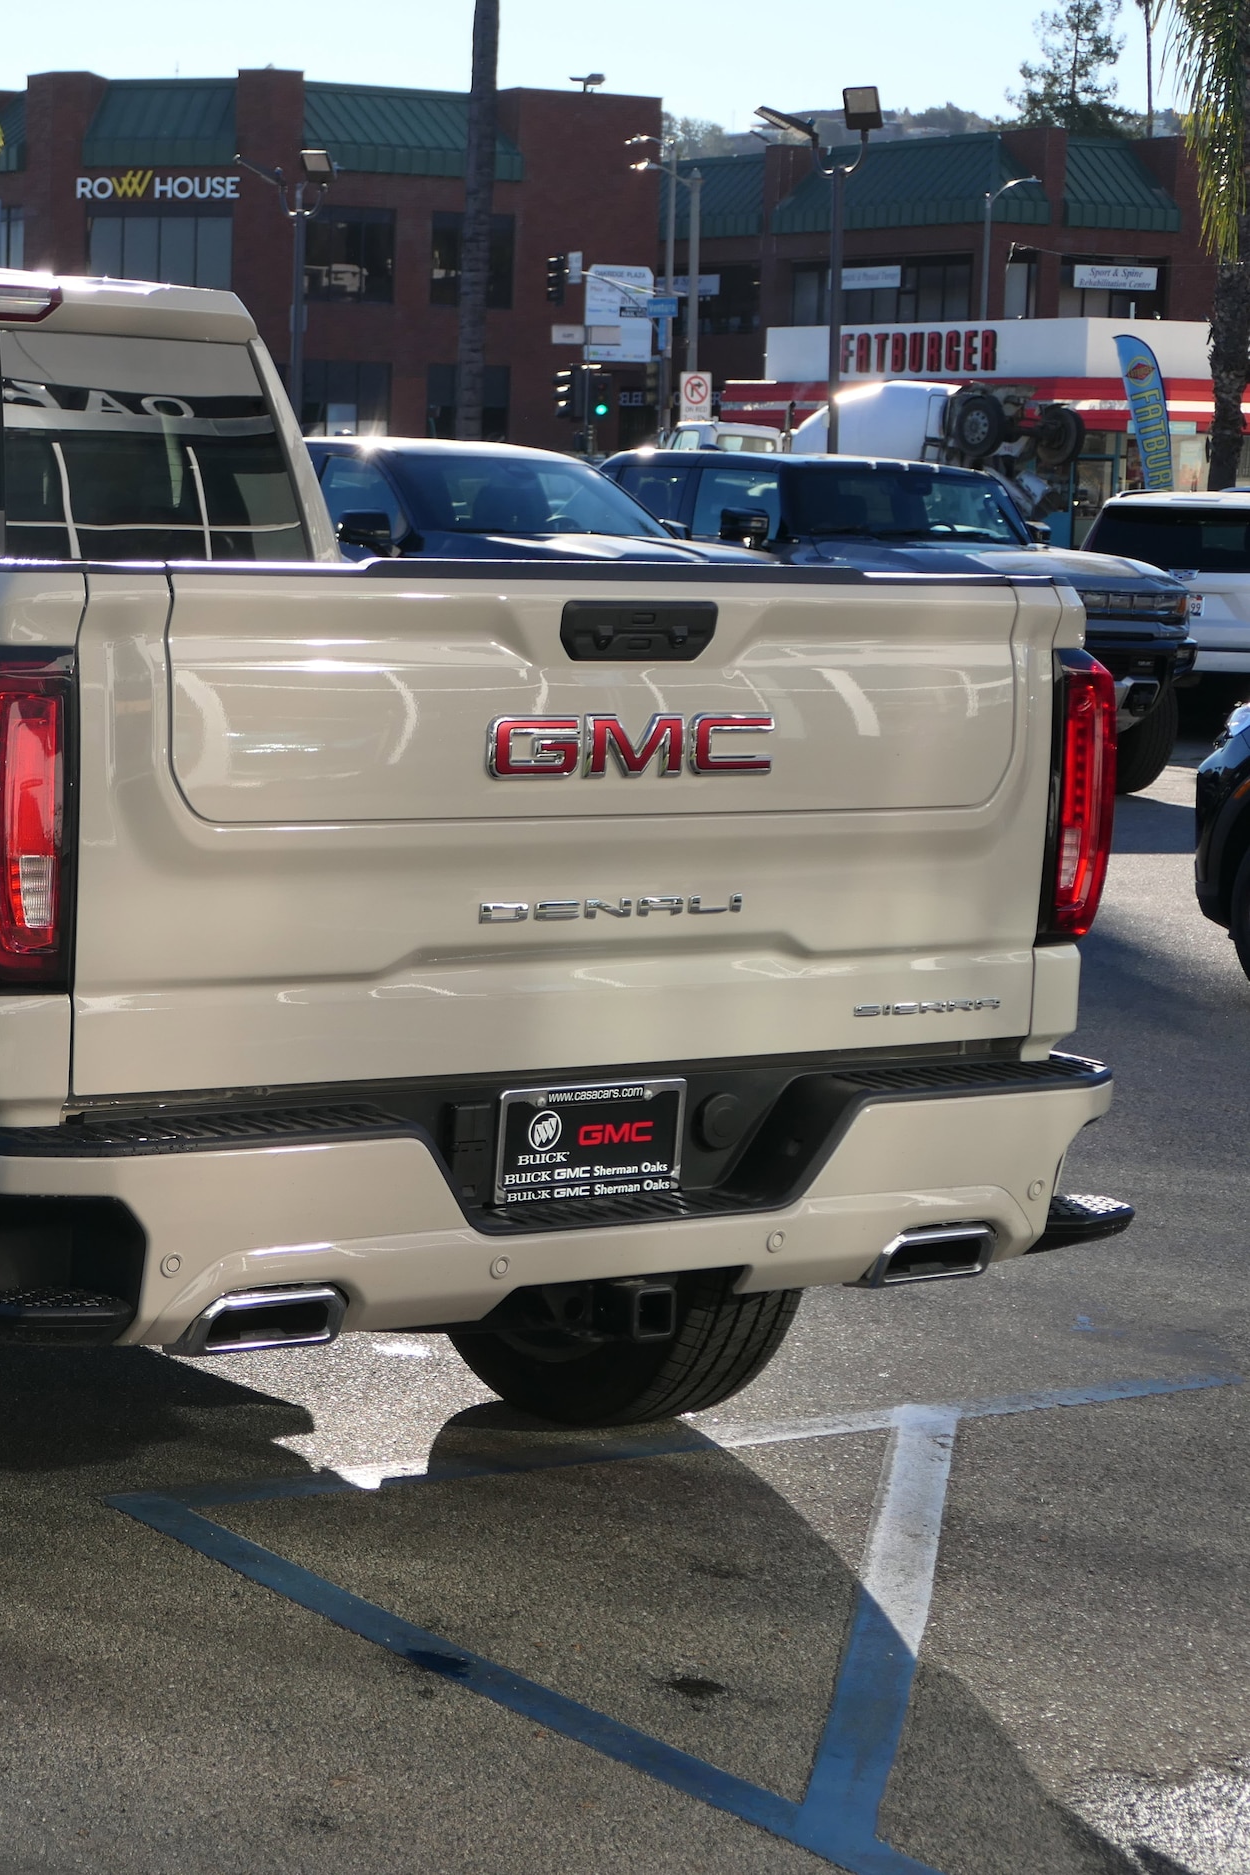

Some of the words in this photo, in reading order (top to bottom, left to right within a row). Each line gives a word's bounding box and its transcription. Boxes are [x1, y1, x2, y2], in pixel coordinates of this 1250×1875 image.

[76, 170, 154, 198] ROW
[154, 176, 241, 199] HOUSE
[627, 271, 646, 279] PLAZA
[1079, 278, 1127, 288] Rehabilitation
[1128, 281, 1152, 289] Center
[1089, 267, 1110, 278] Sport
[1112, 269, 1119, 277] &
[1121, 268, 1143, 279] Spine
[841, 330, 998, 374] FATBURGER
[486, 711, 776, 781] GMC
[478, 892, 743, 924] DENALI
[853, 995, 1001, 1017] SIERRA
[548, 1086, 644, 1103] www.casacars.com
[577, 1121, 654, 1146] GMC
[517, 1151, 569, 1166] BUICK
[504, 1170, 552, 1185] BUICK
[554, 1166, 591, 1180] GMC
[593, 1164, 638, 1177] Sherman
[641, 1161, 668, 1174] Oaks
[506, 1189, 552, 1203] BUICK
[553, 1186, 591, 1199] GMC
[593, 1181, 641, 1195] Sherman
[643, 1178, 671, 1192] Oaks
